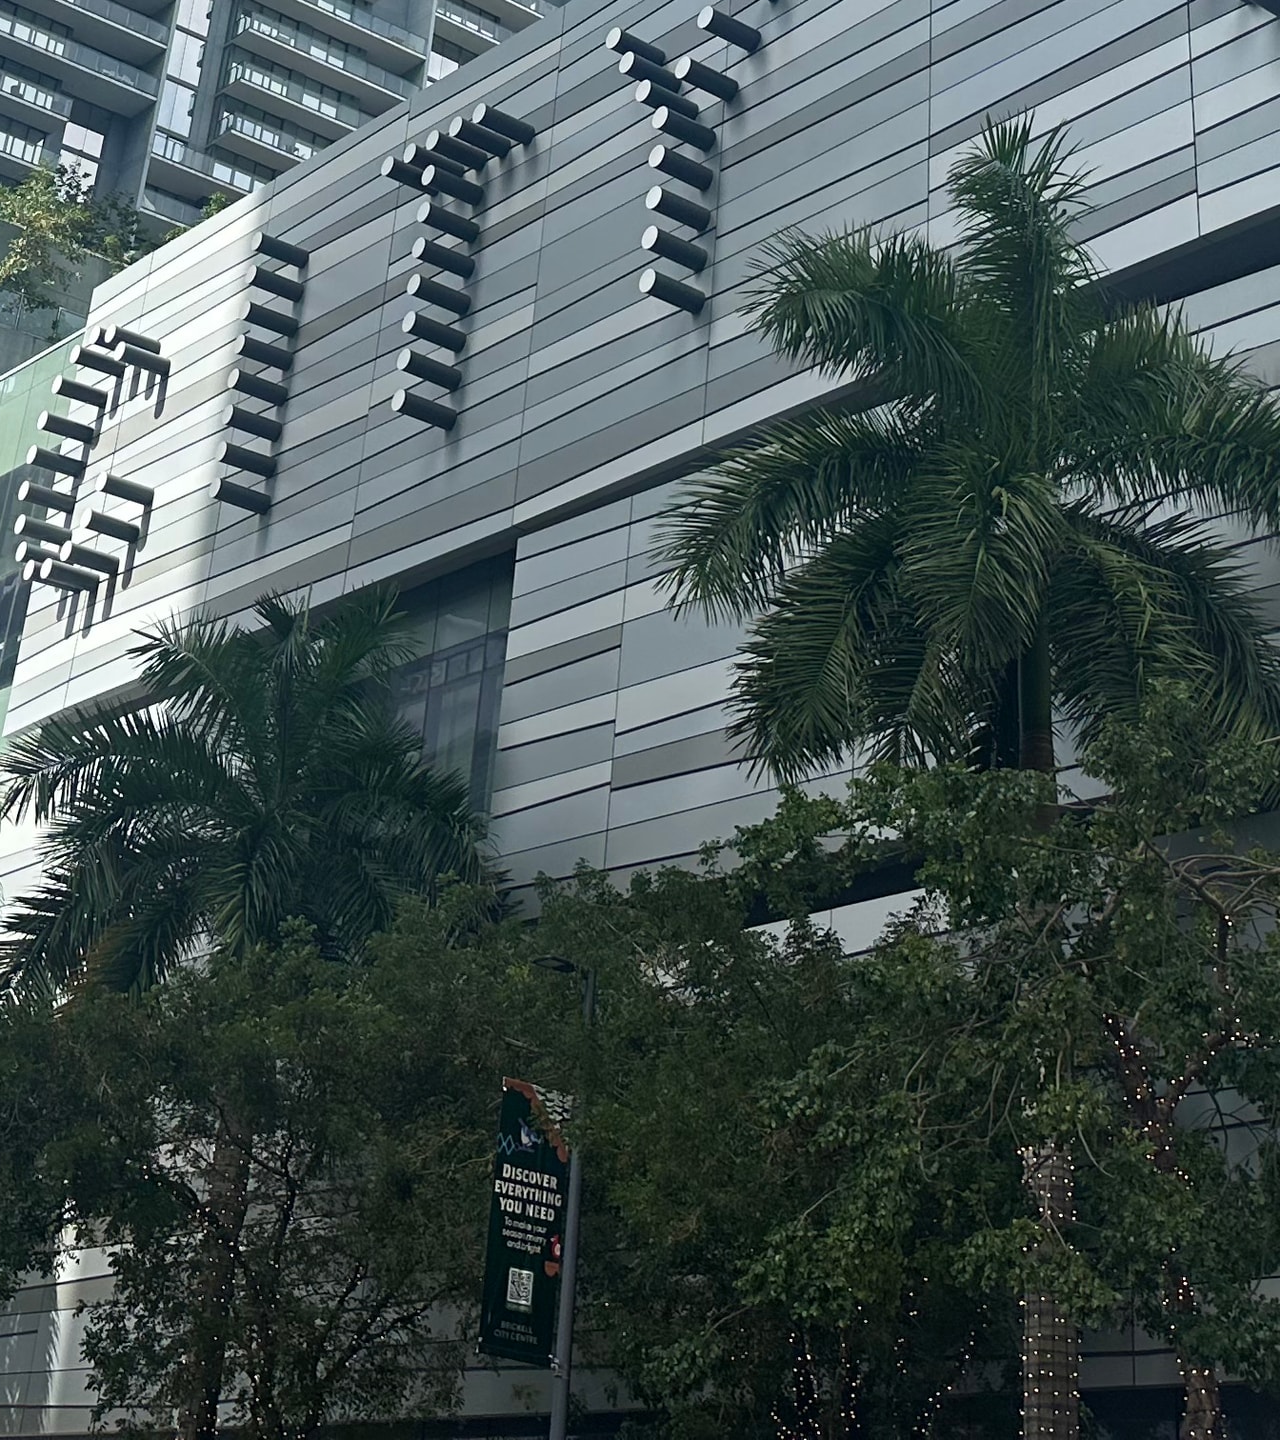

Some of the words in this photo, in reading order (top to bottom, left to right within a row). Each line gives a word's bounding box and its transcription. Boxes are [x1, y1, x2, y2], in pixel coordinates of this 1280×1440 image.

[502, 1163, 558, 1190] DISCOVER
[494, 1179, 562, 1207] EVERYTHING
[499, 1196, 522, 1214] YOU
[525, 1203, 555, 1222] NEED
[504, 1215, 513, 1227] To
[533, 1224, 547, 1234] your
[506, 1240, 521, 1249] and
